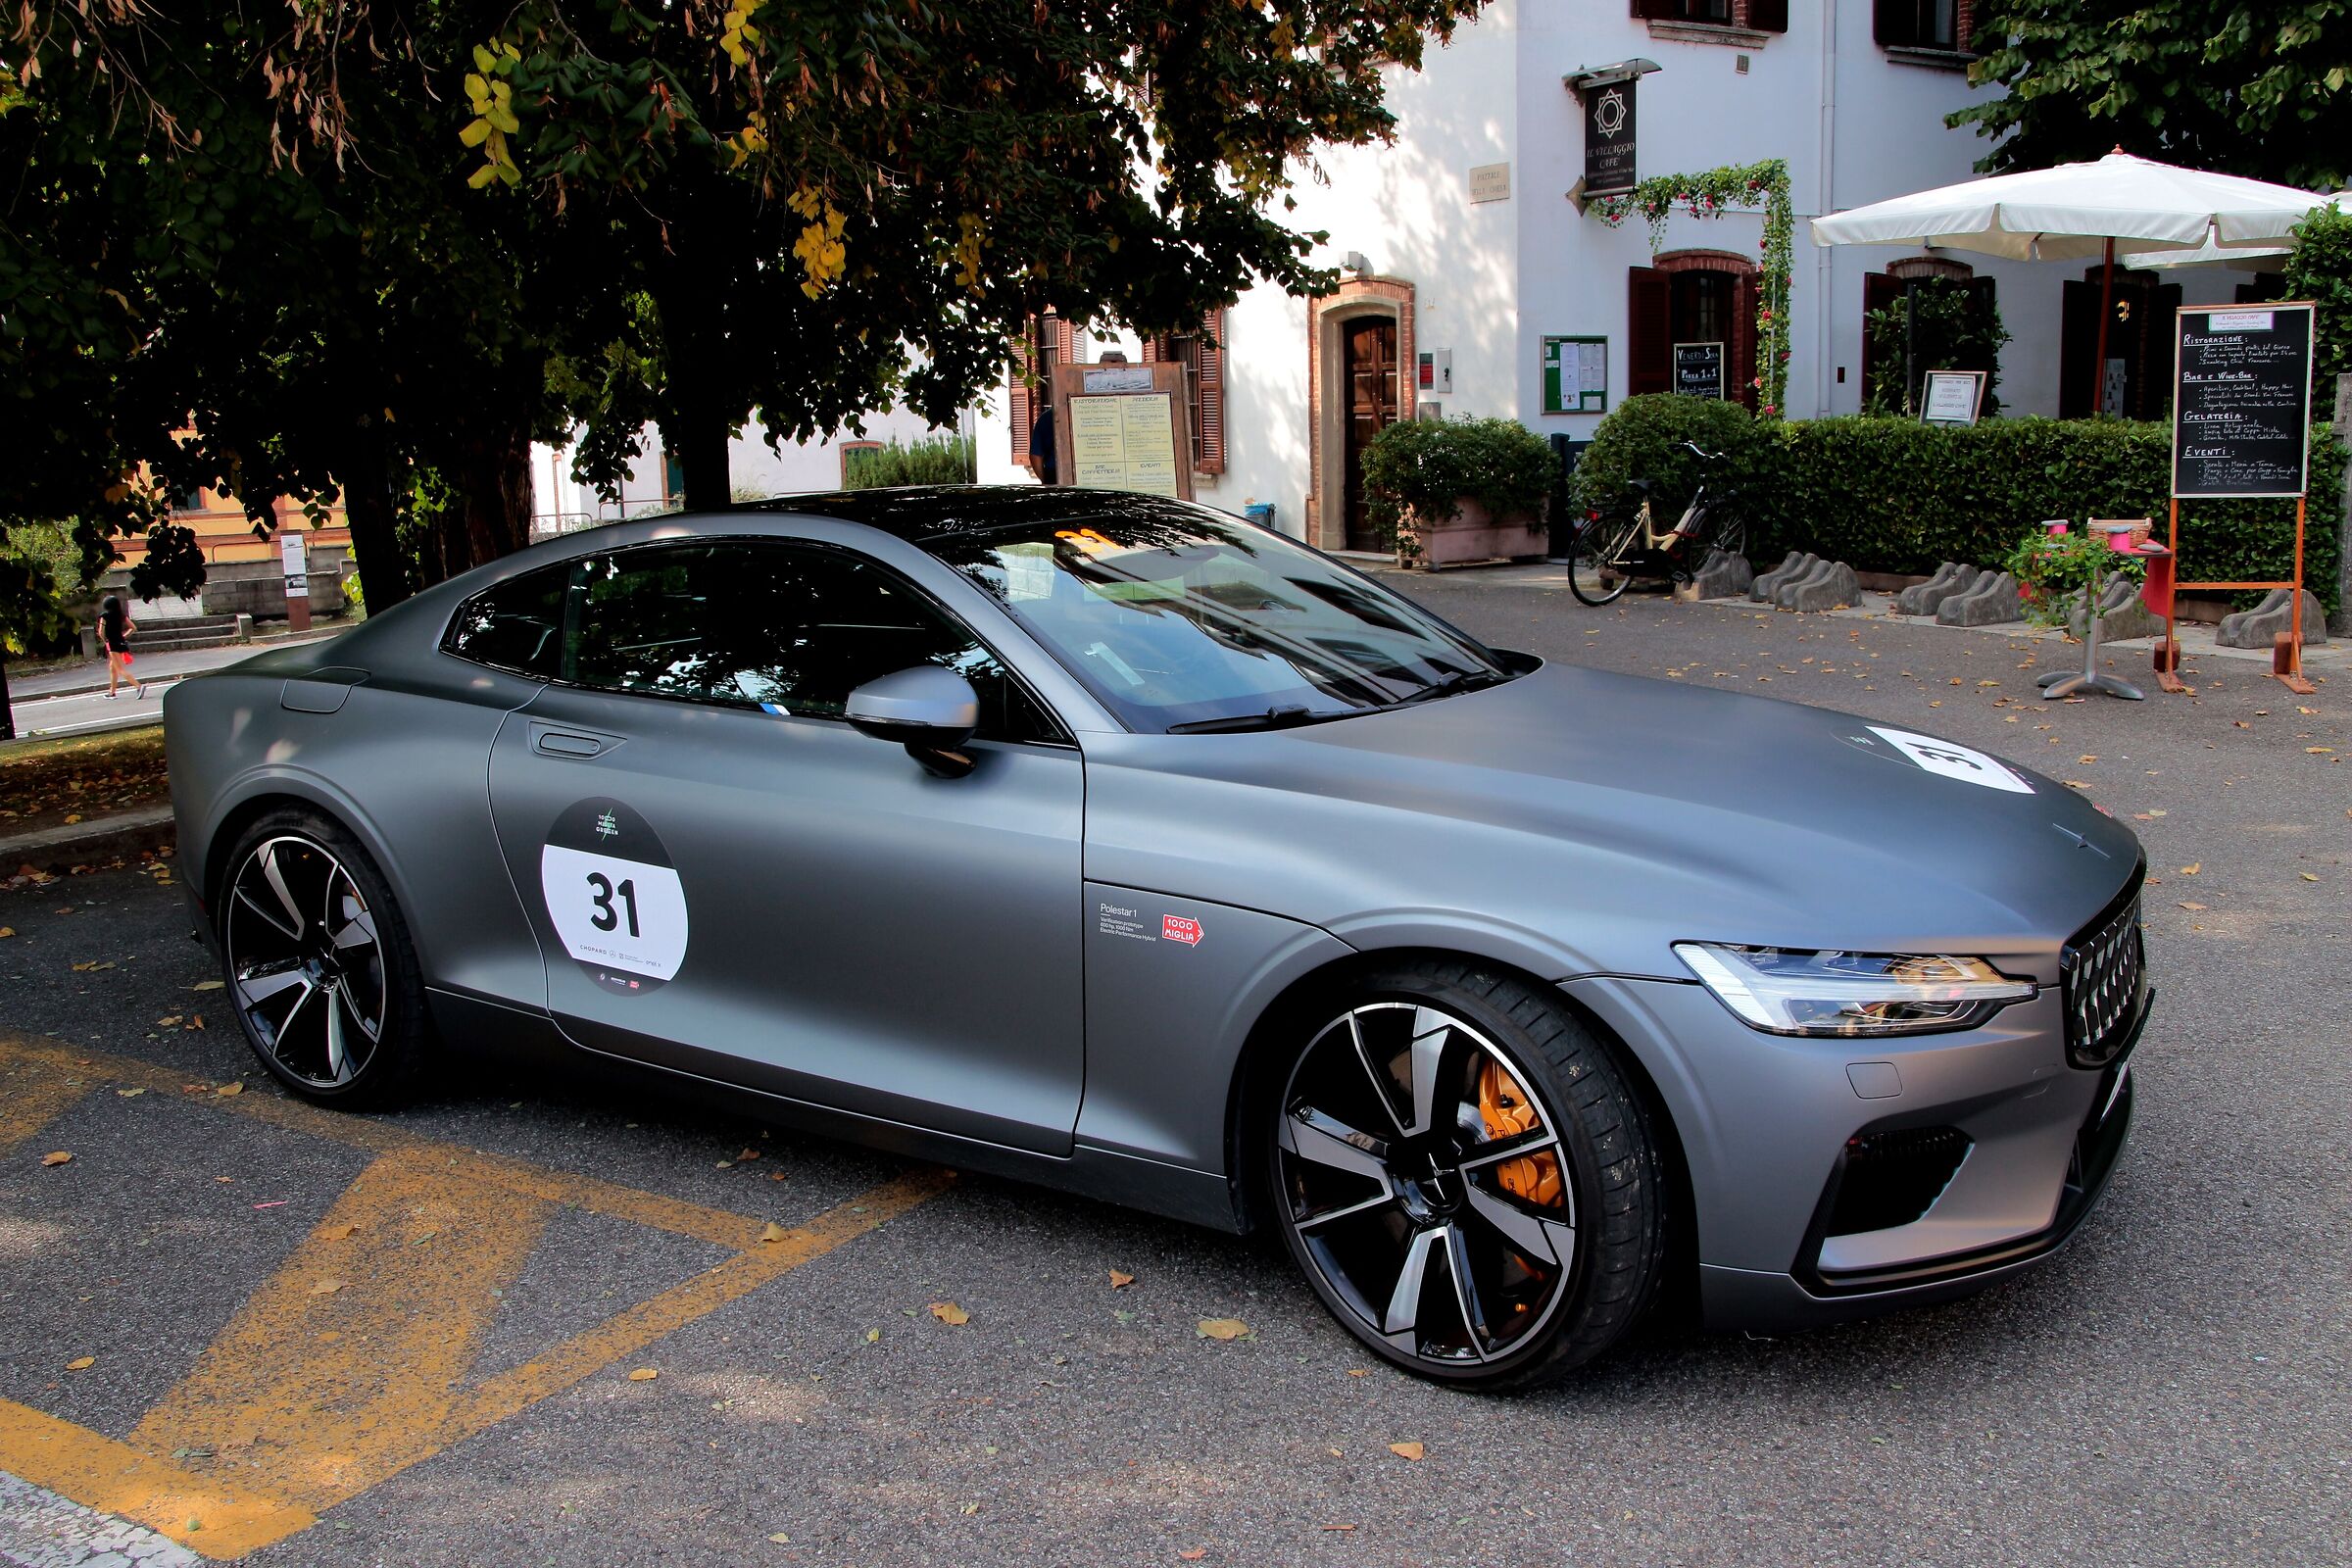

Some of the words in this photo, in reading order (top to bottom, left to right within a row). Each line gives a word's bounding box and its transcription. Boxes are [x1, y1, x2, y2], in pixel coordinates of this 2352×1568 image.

[586, 871, 640, 938] 31
[1100, 903, 1133, 917] Polestar
[1133, 908, 1137, 918] 1
[1167, 918, 1194, 930] 1000
[1164, 928, 1195, 941] MIGLIA
[579, 944, 608, 956] CHOPARD
